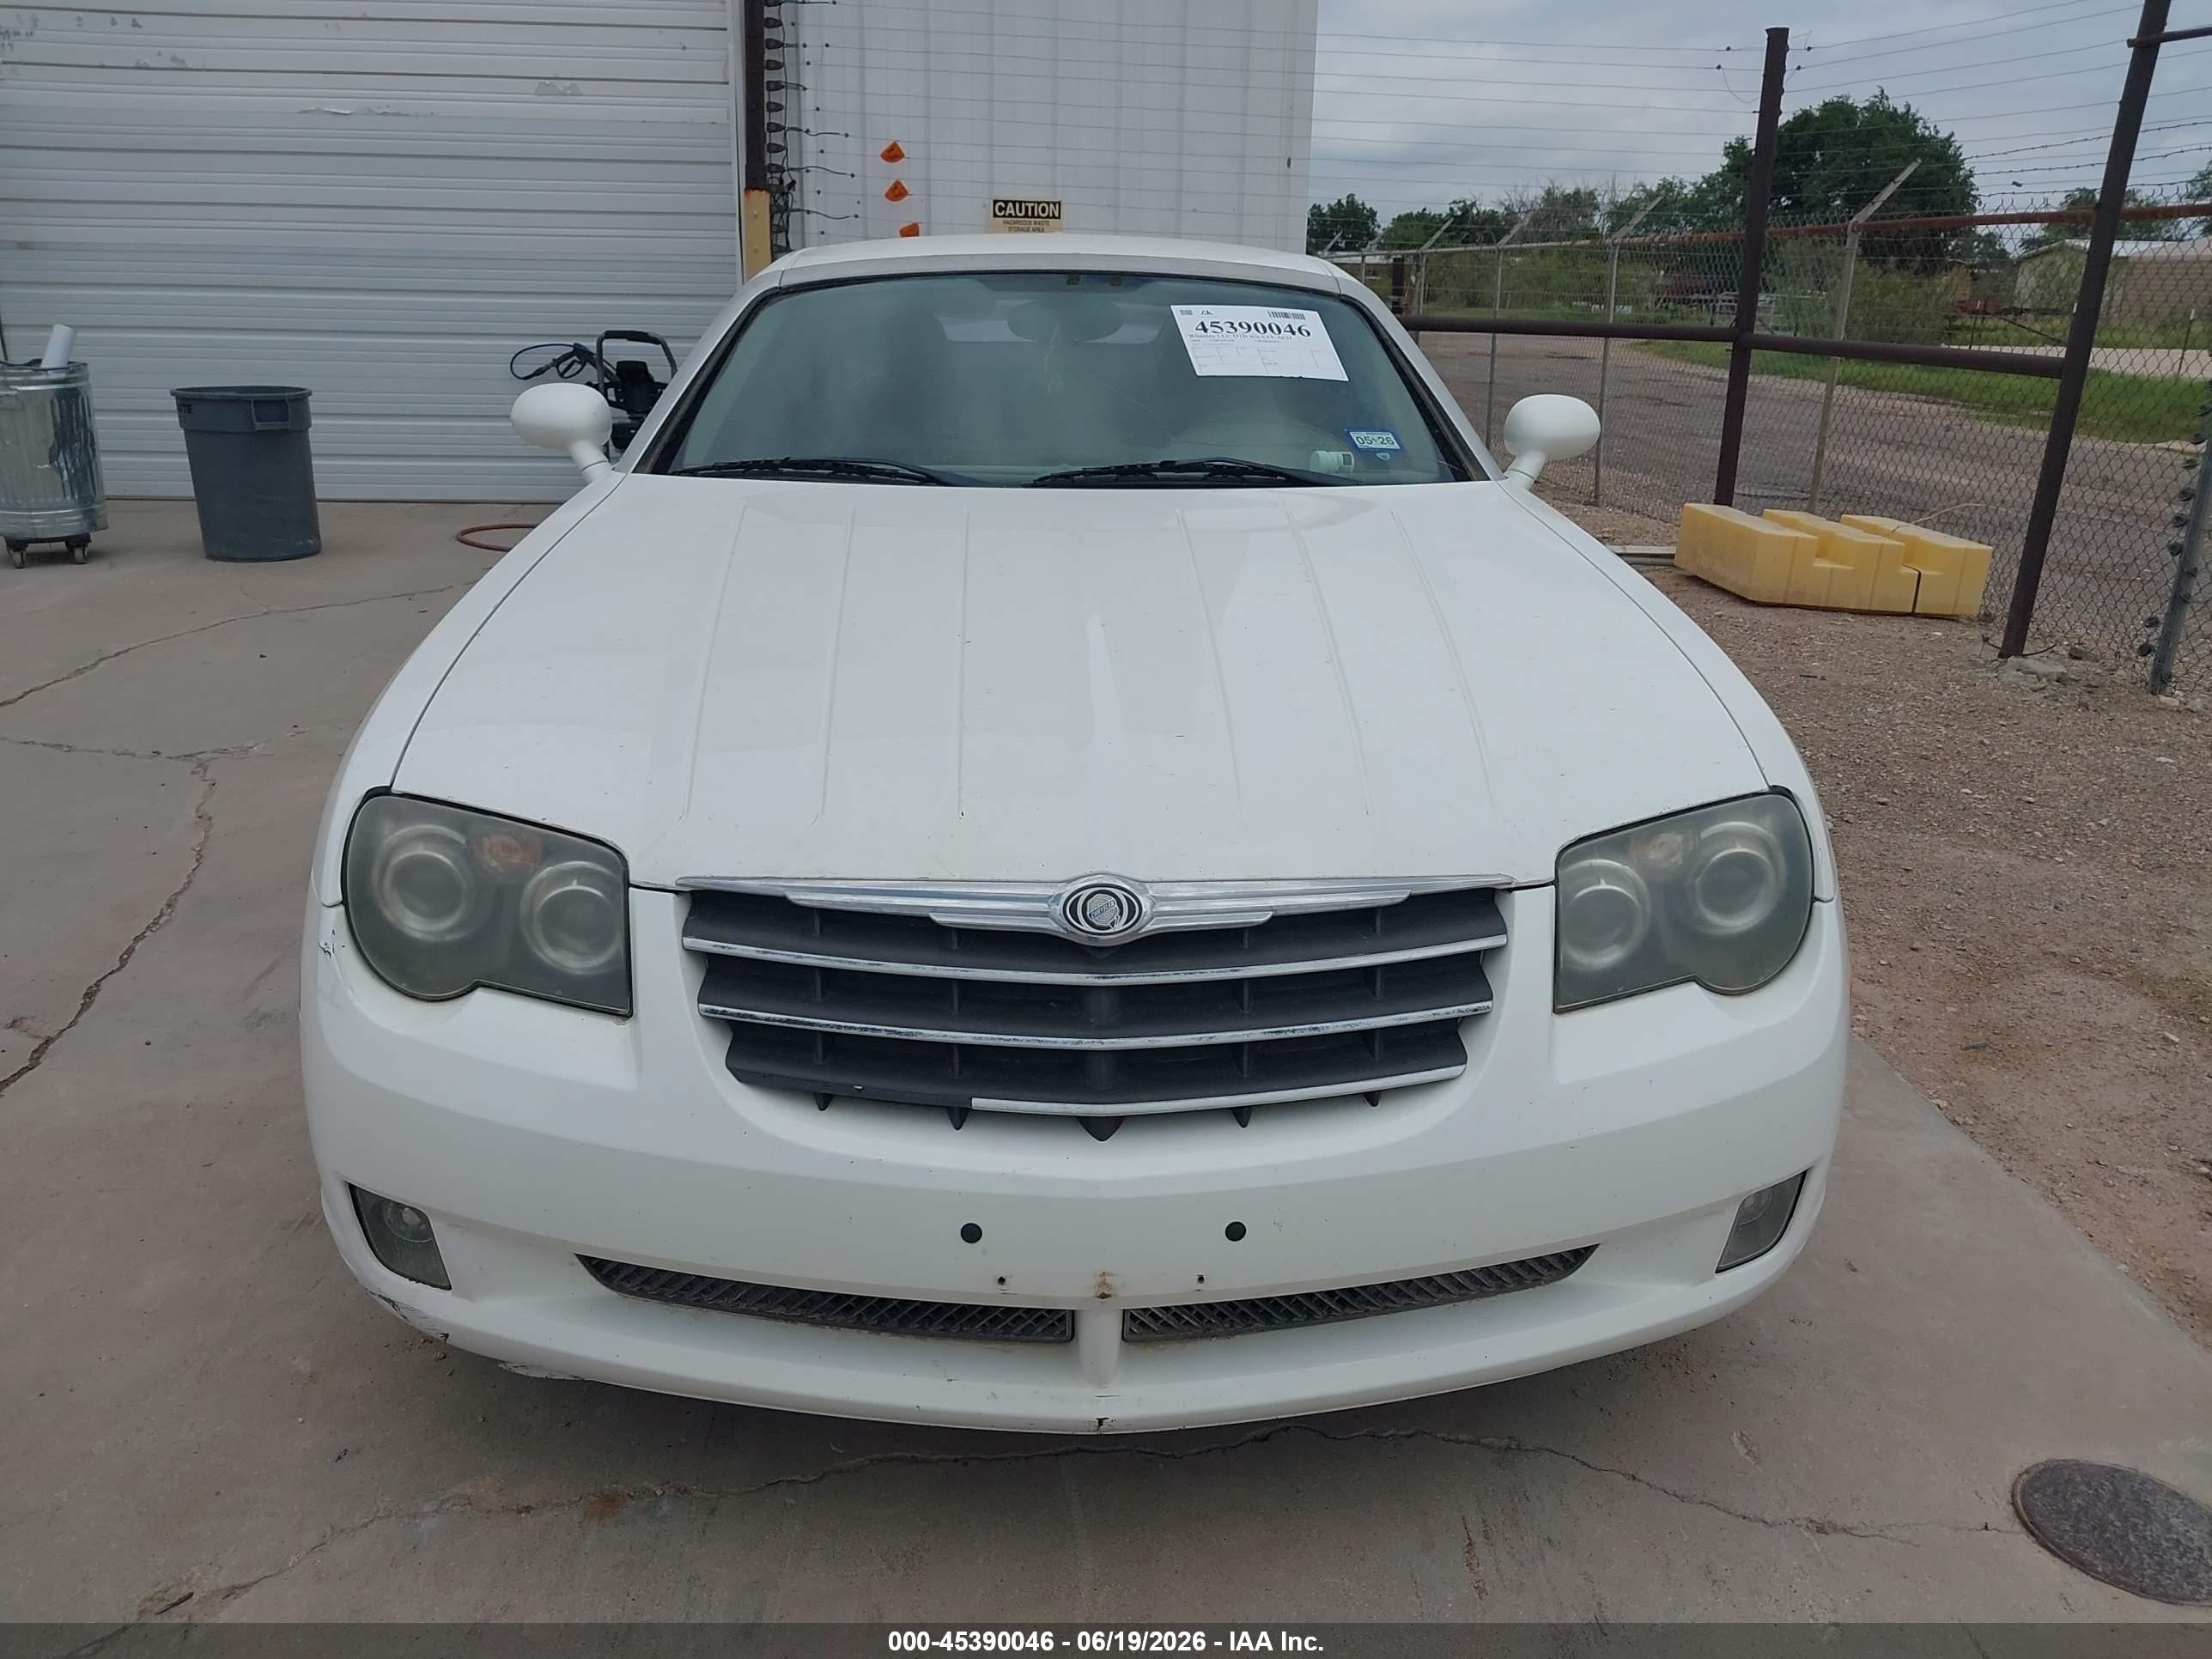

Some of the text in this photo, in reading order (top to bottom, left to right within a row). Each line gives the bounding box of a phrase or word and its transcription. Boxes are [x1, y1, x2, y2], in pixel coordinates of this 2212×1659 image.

[994, 201, 1060, 217] CAUTION
[1194, 320, 1311, 337] 45390046
[1090, 899, 1116, 920] CHRYSLER
